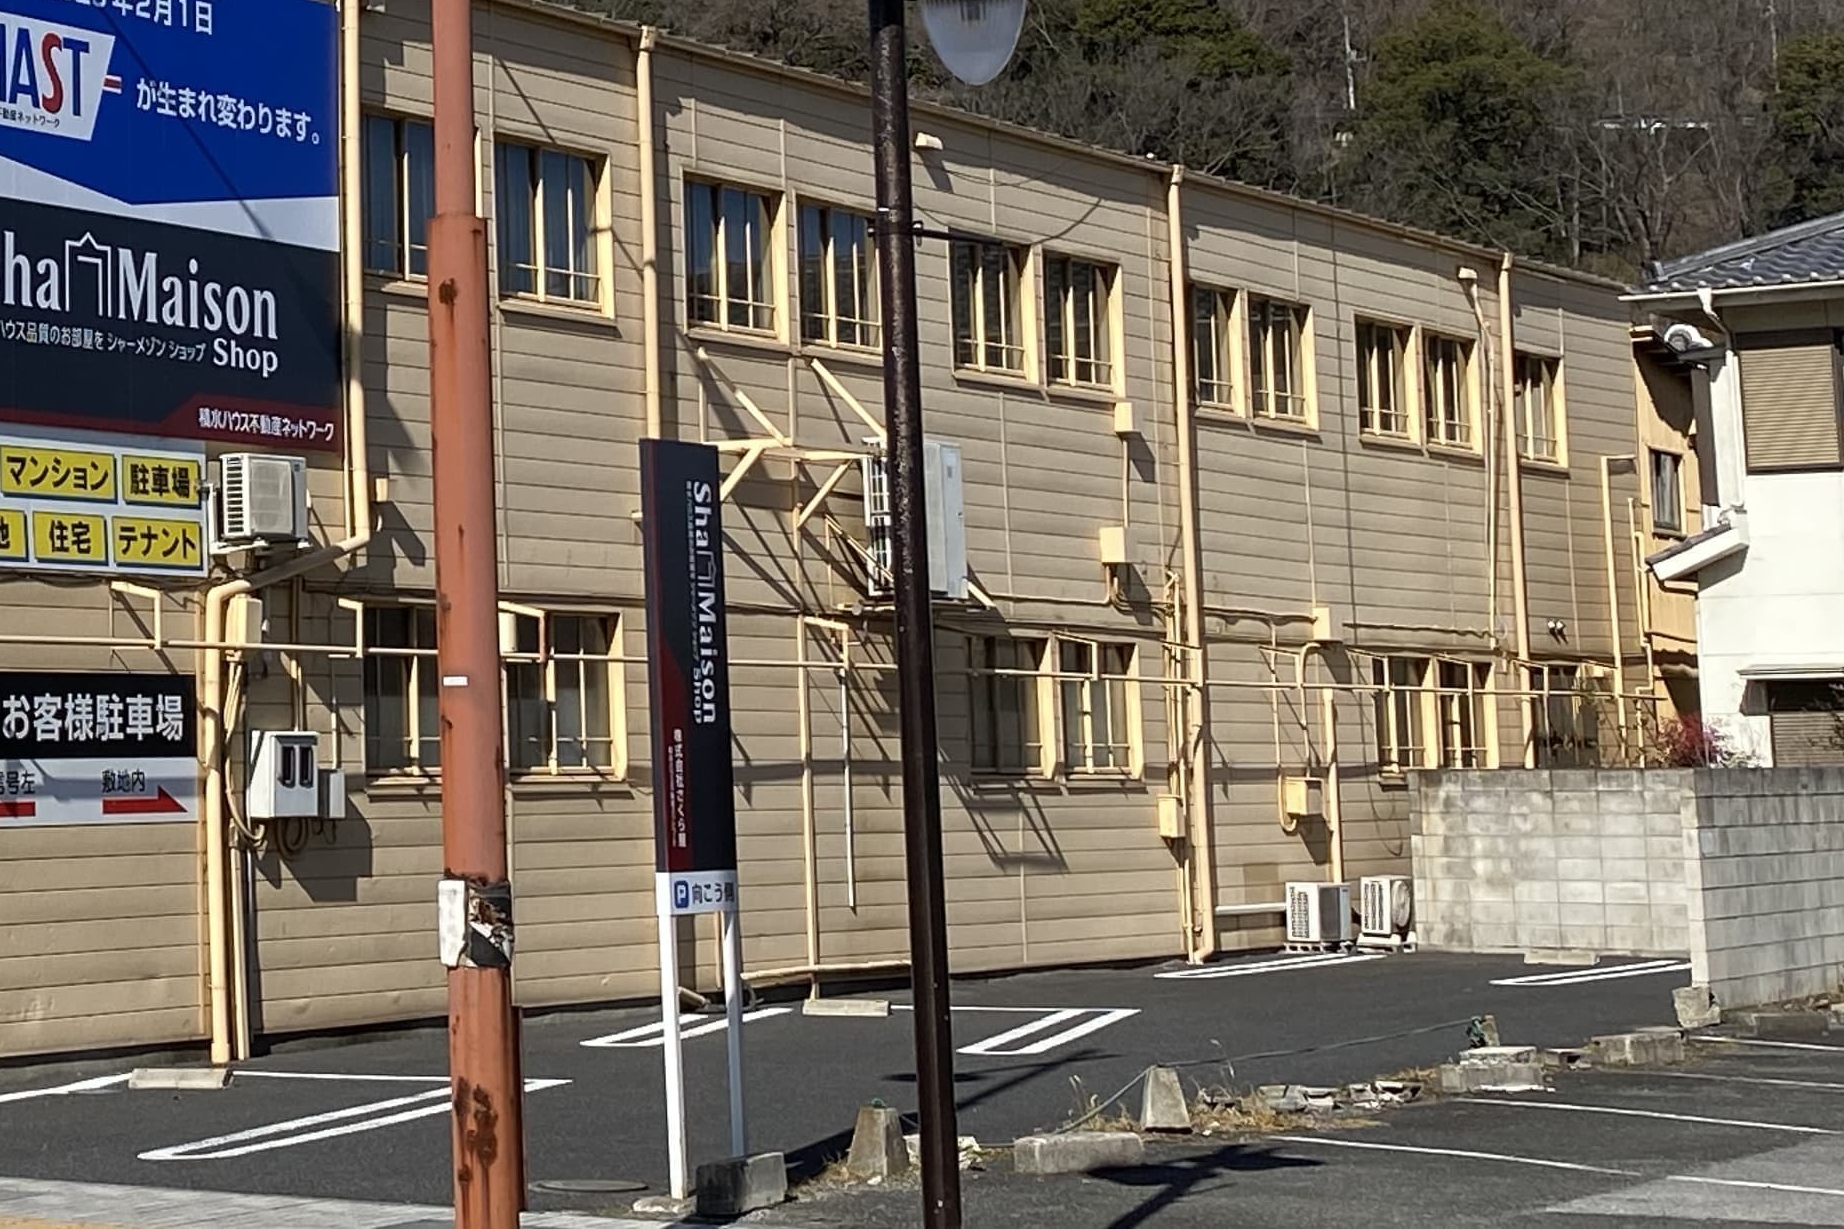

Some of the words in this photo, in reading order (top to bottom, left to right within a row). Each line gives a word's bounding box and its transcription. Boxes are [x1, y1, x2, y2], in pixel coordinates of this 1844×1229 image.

[136, 77, 321, 146] が生まれ変わります。
[118, 247, 278, 340] Maison
[213, 338, 278, 378] Shop
[6, 454, 109, 492] マンション
[130, 463, 190, 499] 駐車場
[693, 481, 712, 547] Sha
[48, 519, 92, 555] 住宅
[119, 525, 196, 559] テナント
[697, 592, 718, 723] Maison
[2, 692, 184, 742] お客様駐車場
[101, 768, 145, 793] 敷地内
